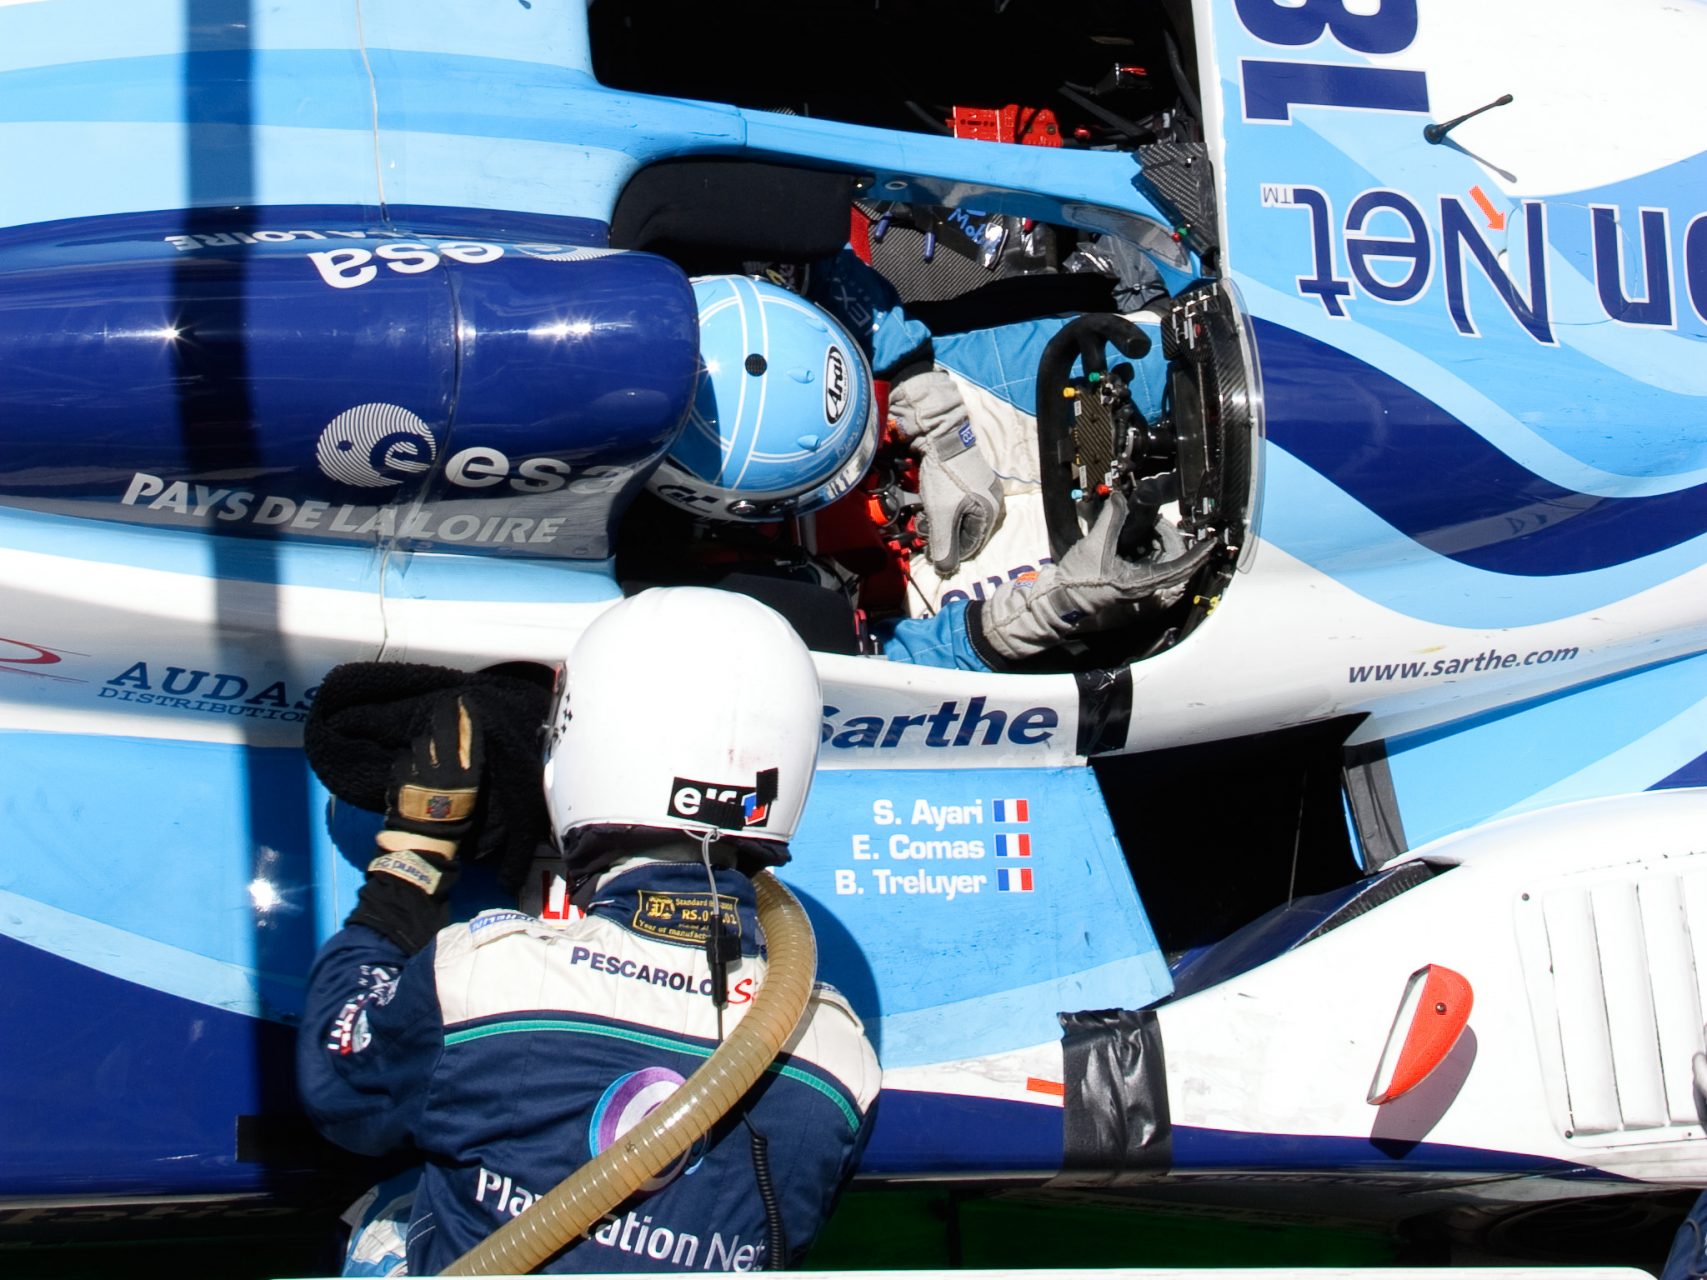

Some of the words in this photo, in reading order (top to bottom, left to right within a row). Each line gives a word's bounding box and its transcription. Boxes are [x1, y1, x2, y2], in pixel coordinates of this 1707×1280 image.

[306, 241, 505, 290] esa
[828, 355, 844, 422] Arai
[445, 447, 635, 495] esa
[121, 472, 256, 522] PAYS
[252, 496, 333, 532] DE
[330, 504, 400, 539] LA
[402, 512, 566, 544] LOIRE
[1346, 642, 1580, 685] www.sarthe.com
[872, 799, 903, 825] S.
[911, 798, 984, 831] Ayari
[852, 835, 881, 861] E.
[891, 835, 986, 861] Comas
[835, 869, 865, 895] B.
[877, 869, 987, 901] Treluyer
[570, 945, 714, 998] PESCAROLO
